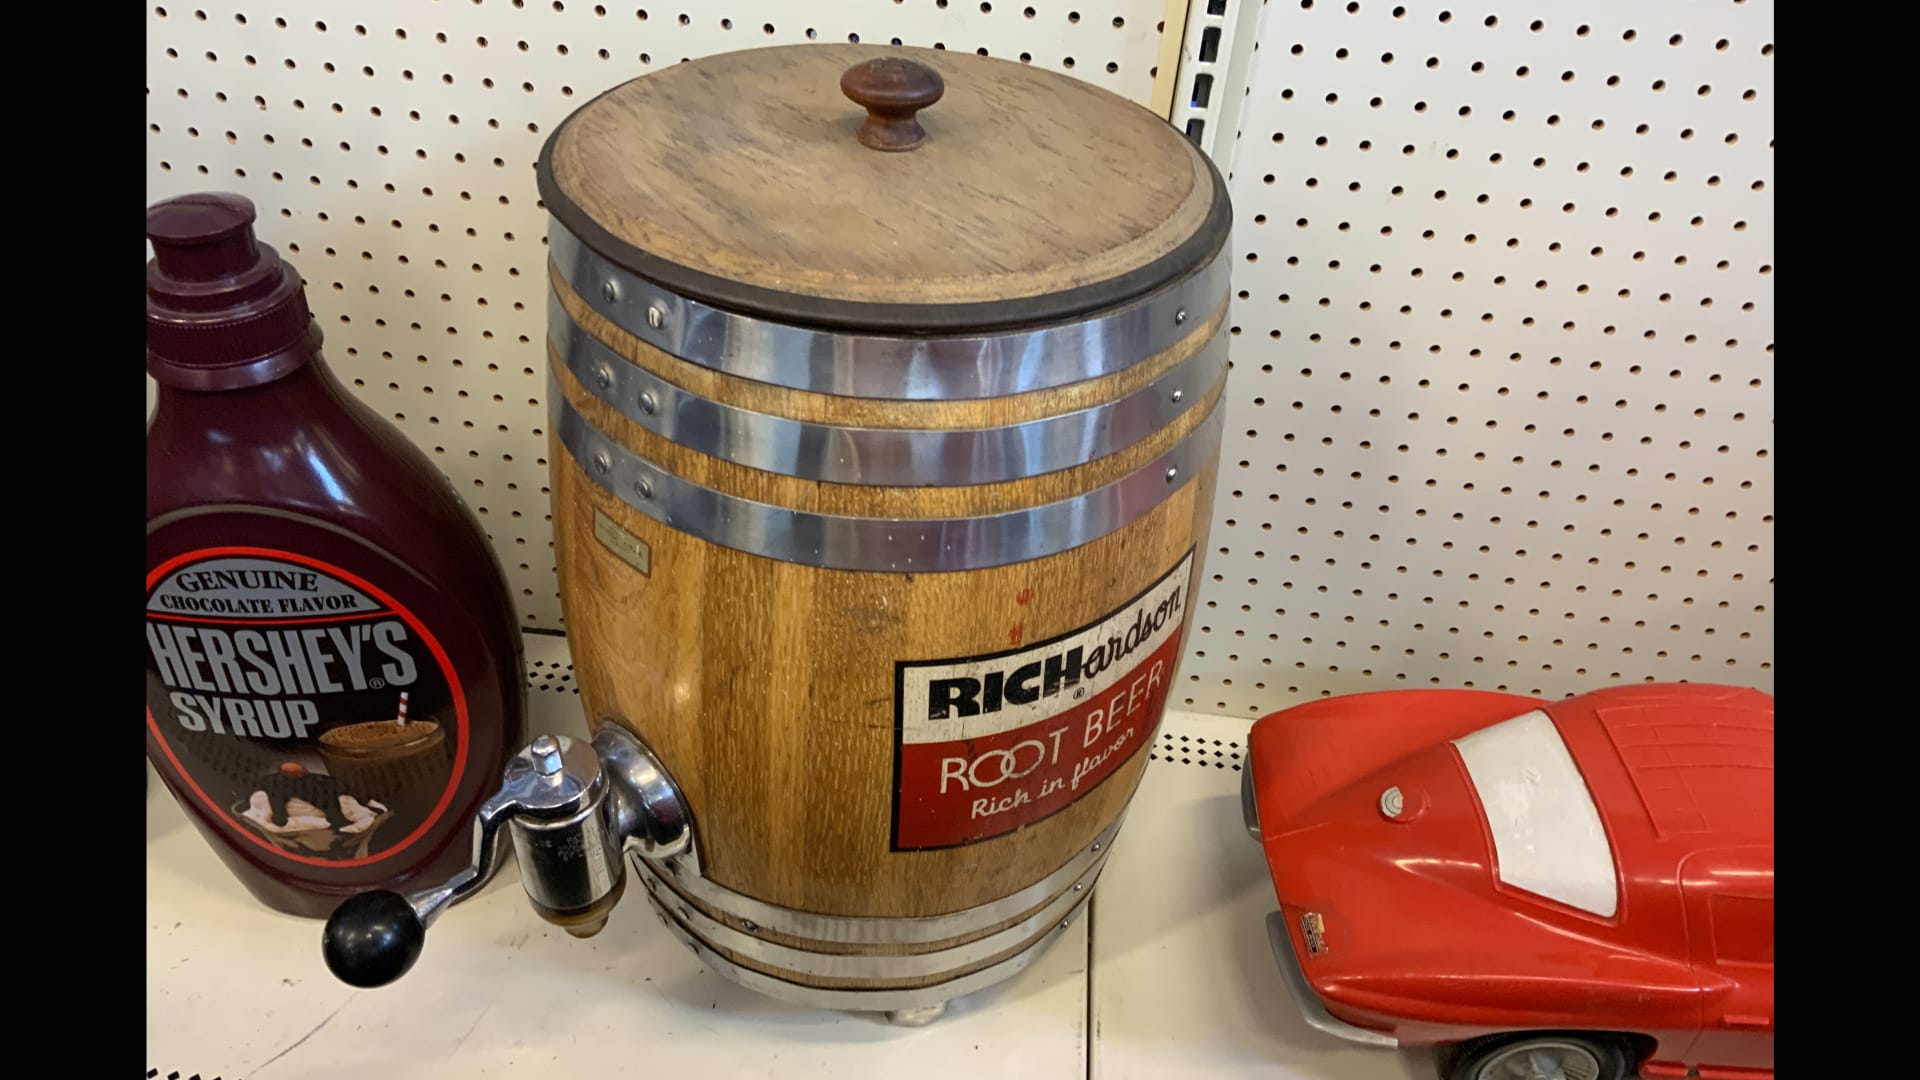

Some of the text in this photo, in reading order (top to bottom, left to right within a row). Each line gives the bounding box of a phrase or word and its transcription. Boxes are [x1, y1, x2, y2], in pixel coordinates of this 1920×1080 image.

[159, 594, 358, 614] CHOCOLATE FLAVOR
[175, 569, 318, 593] GENUINE
[147, 621, 418, 695] HERSHEY'S
[170, 692, 319, 739] SYRUP
[940, 659, 1164, 794] ROOT BEER
[971, 728, 1135, 819] Rich in flavor
